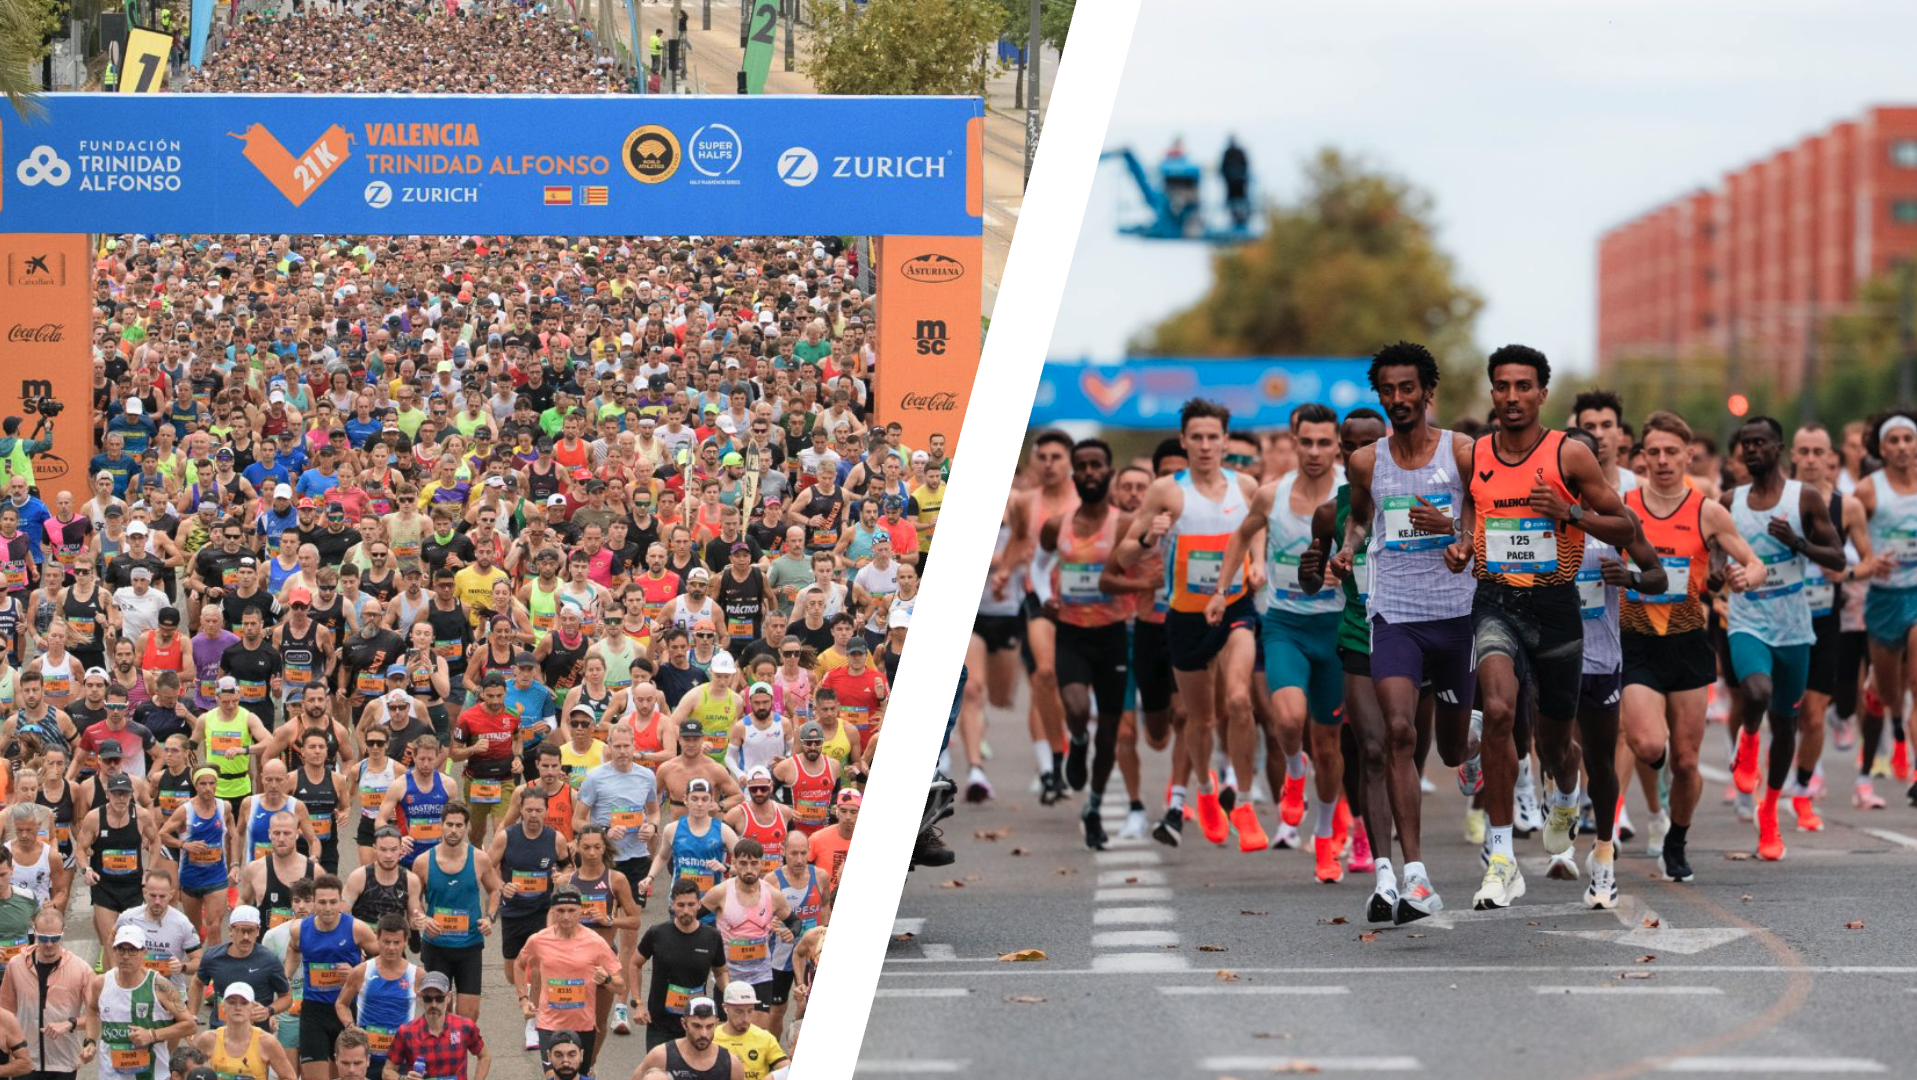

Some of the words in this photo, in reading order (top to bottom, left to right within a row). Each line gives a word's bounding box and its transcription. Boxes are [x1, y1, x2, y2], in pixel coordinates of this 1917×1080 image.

[751, 5, 779, 45] 2
[135, 53, 161, 93] 1
[365, 123, 479, 146] VALENCIA
[80, 139, 180, 152] FUNDACIÓN
[698, 141, 733, 150] SUPER
[698, 150, 733, 159] HALFS
[79, 156, 181, 172] TRINIDAD
[366, 154, 483, 174] TRINIDAD
[489, 155, 610, 176] ALFONSO
[832, 155, 945, 178] ZURICH
[79, 175, 181, 191] ALFONSO
[402, 187, 477, 202] ZURICH
[907, 265, 959, 276] ASTURIANA
[1509, 535, 1530, 546] 125
[1506, 551, 1535, 560] PACER
[726, 603, 759, 615] PRÁCTICO
